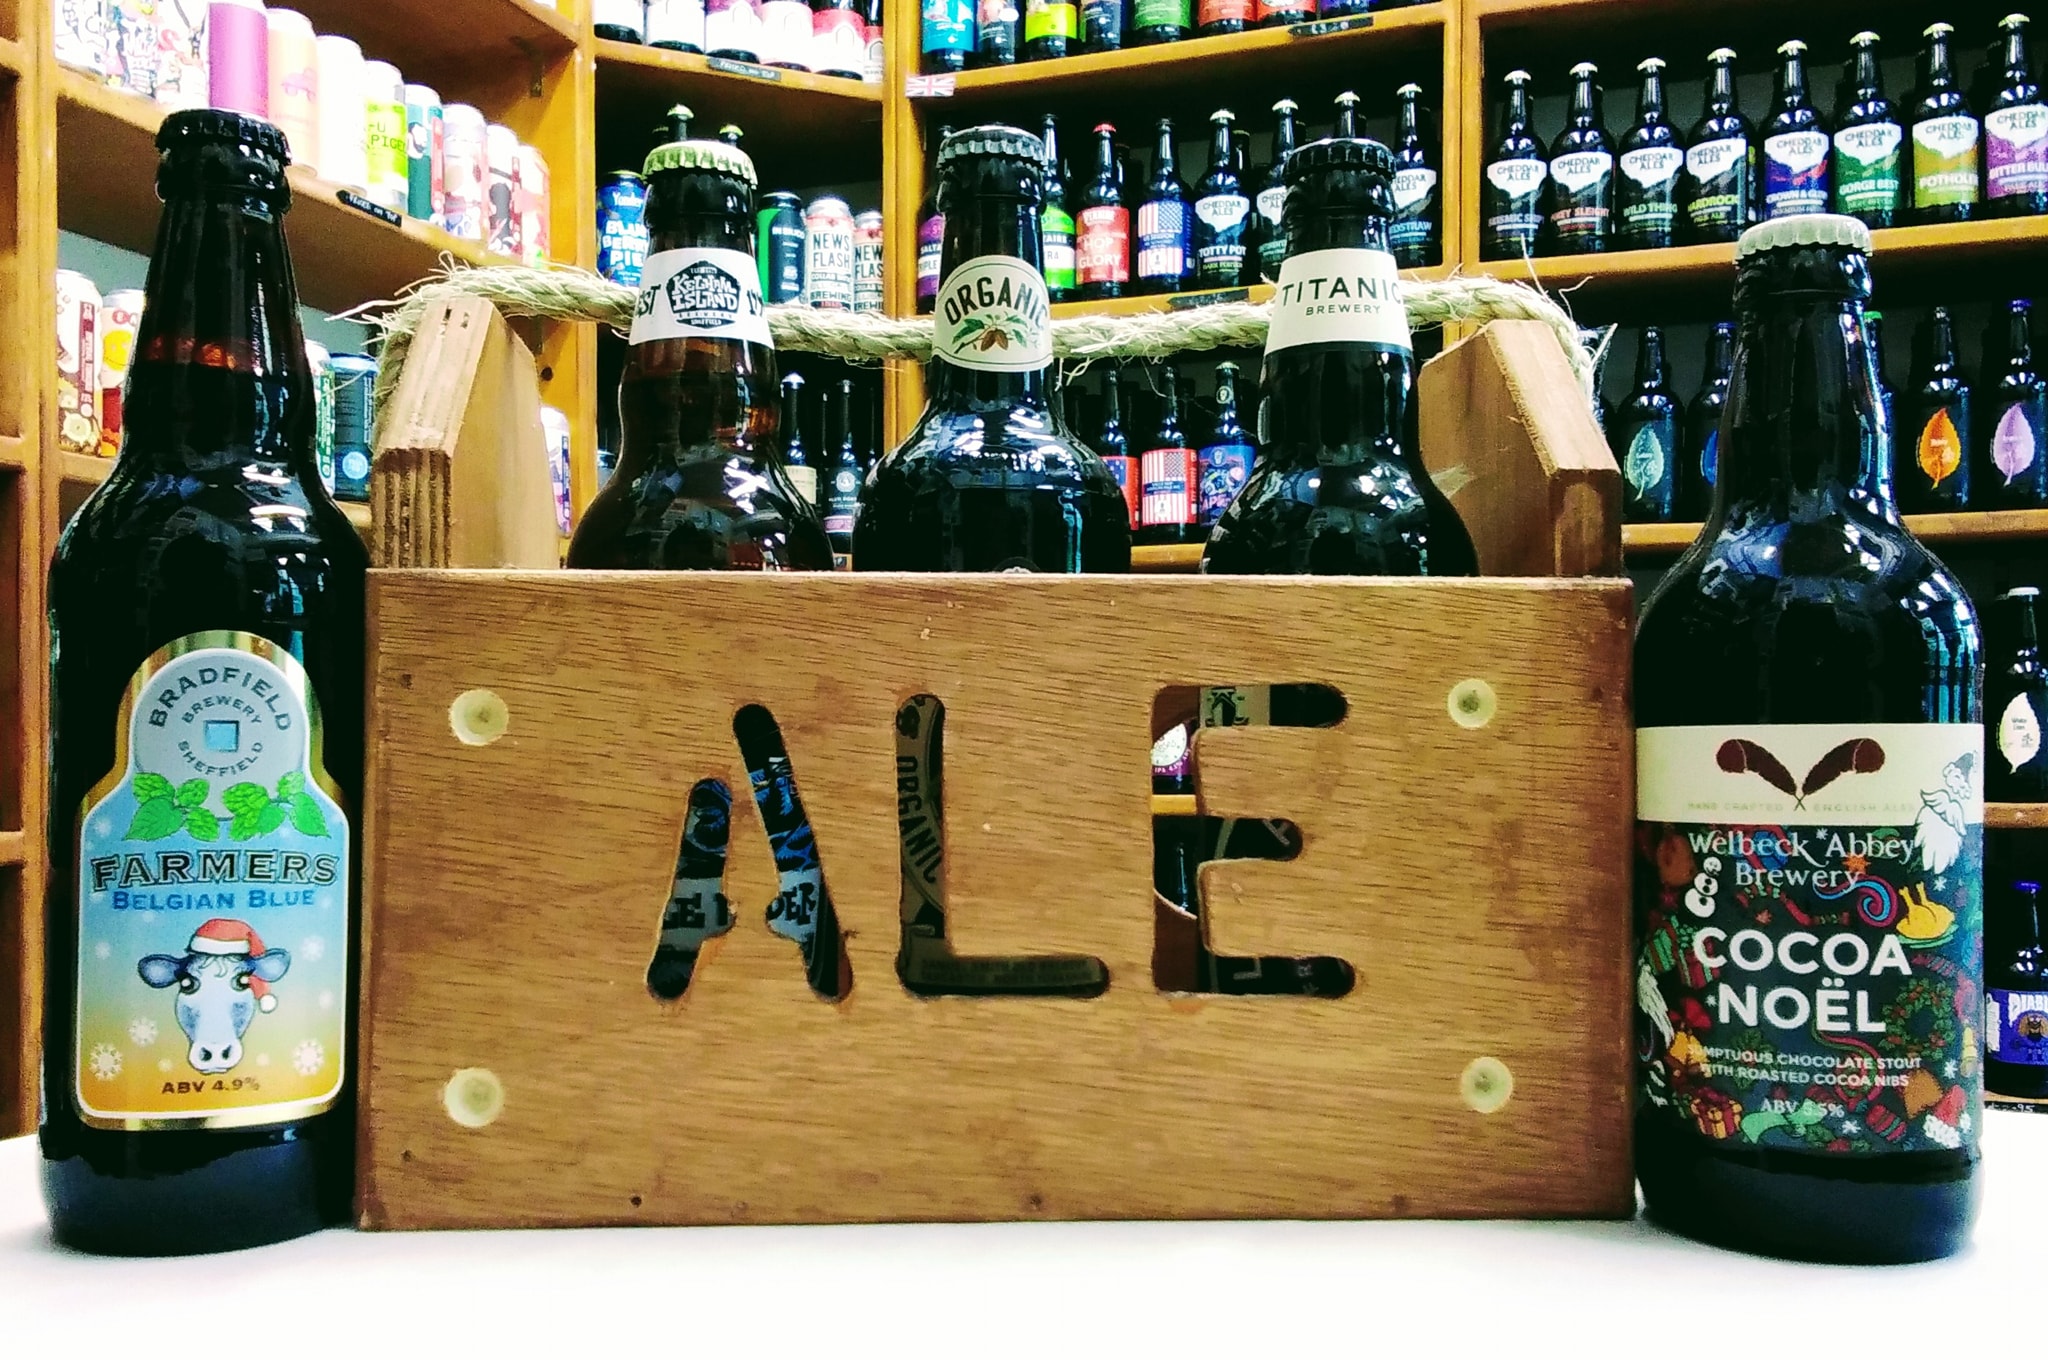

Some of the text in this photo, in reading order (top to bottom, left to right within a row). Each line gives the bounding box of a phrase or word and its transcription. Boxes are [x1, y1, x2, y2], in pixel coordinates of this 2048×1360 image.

[813, 232, 850, 252] NEWS
[1083, 235, 1114, 252] HOP
[1199, 244, 1228, 258] TOTTY
[1229, 244, 1247, 256] POT
[813, 251, 850, 270] FLASH
[855, 244, 883, 263] NEW
[1079, 253, 1121, 270] GLORY
[855, 263, 883, 281] FLAS
[672, 273, 737, 294] KELHAM
[1282, 277, 1400, 307] TITANIC
[671, 290, 738, 311] ISLAND
[944, 276, 1048, 330] ORGANIC
[1305, 303, 1381, 316] BREWERY
[149, 666, 292, 731] BRADFIELD
[181, 695, 262, 725] BREWERY
[177, 740, 263, 777] SHEFFIELD
[1688, 801, 1718, 811] HAND
[1723, 802, 1784, 812] CRAFTED
[1813, 802, 1877, 813] ENGLISH
[646, 683, 1357, 1004] ALE
[1688, 829, 1916, 868] Welbeck Abbey
[90, 849, 341, 893] FARMERS
[1735, 861, 1869, 892] Brewery
[112, 889, 316, 911] BELGIAN BLUE
[1693, 926, 1913, 977] COCOA
[1717, 976, 1887, 1033] NOËL
[1777, 1053, 1873, 1071] CHOCOLATE
[1877, 1057, 1922, 1070] STOUT
[161, 1076, 261, 1094] ABV 4.9%
[1737, 1065, 1810, 1084] ROASTED
[1814, 1072, 1872, 1087] COCOA
[1875, 1073, 1910, 1087] NIBS
[1760, 1098, 1799, 1115] ABV
